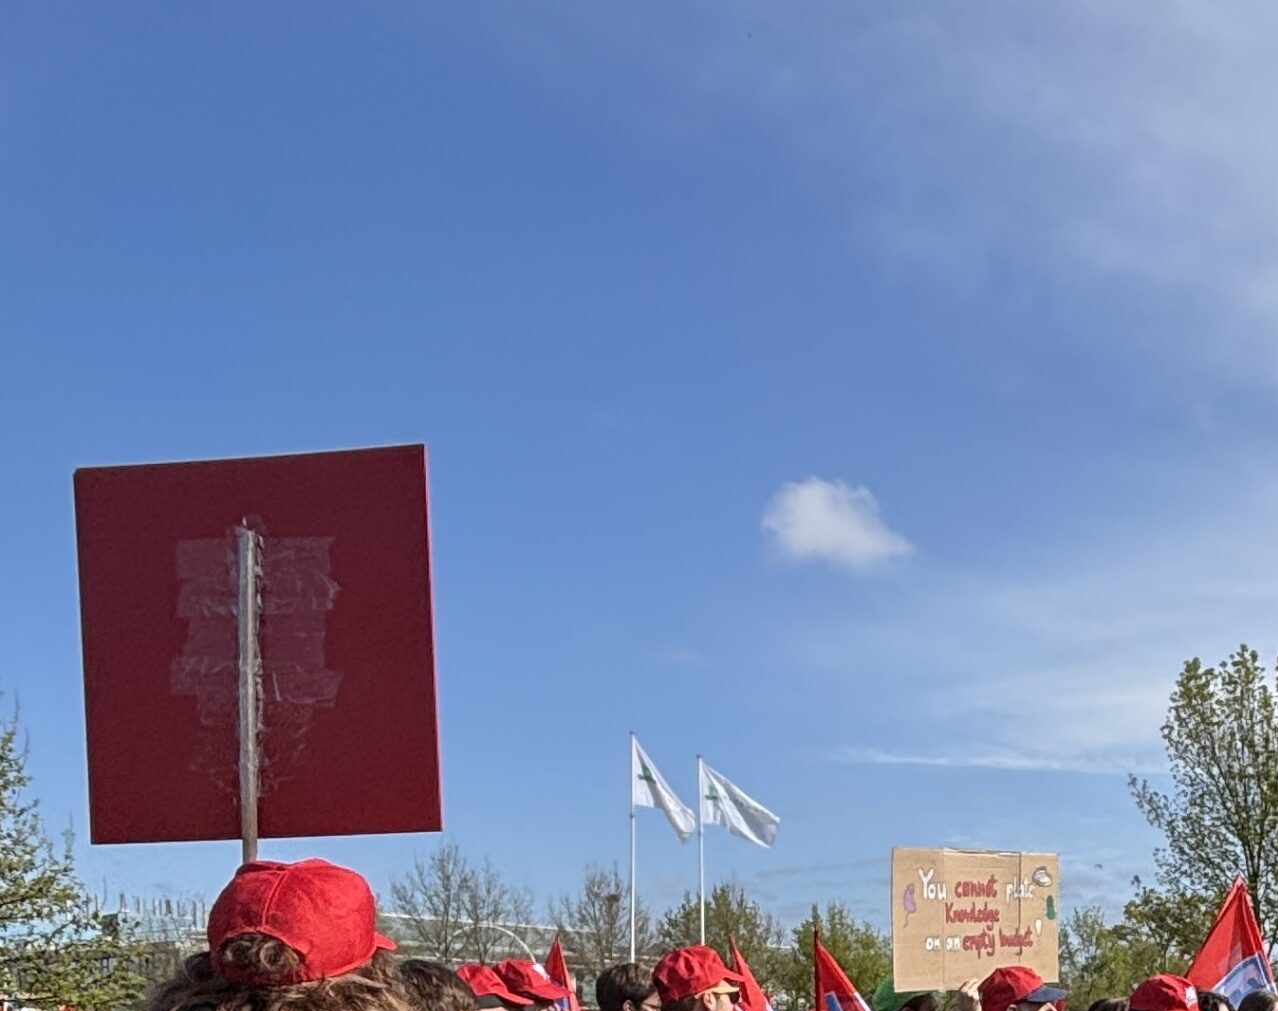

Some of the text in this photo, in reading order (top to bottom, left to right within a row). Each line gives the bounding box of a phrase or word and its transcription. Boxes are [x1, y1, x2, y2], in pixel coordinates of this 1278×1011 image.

[918, 867, 1034, 903] You cannot plate
[925, 936, 940, 950] on
[946, 936, 961, 950] an
[962, 929, 995, 959] empty
